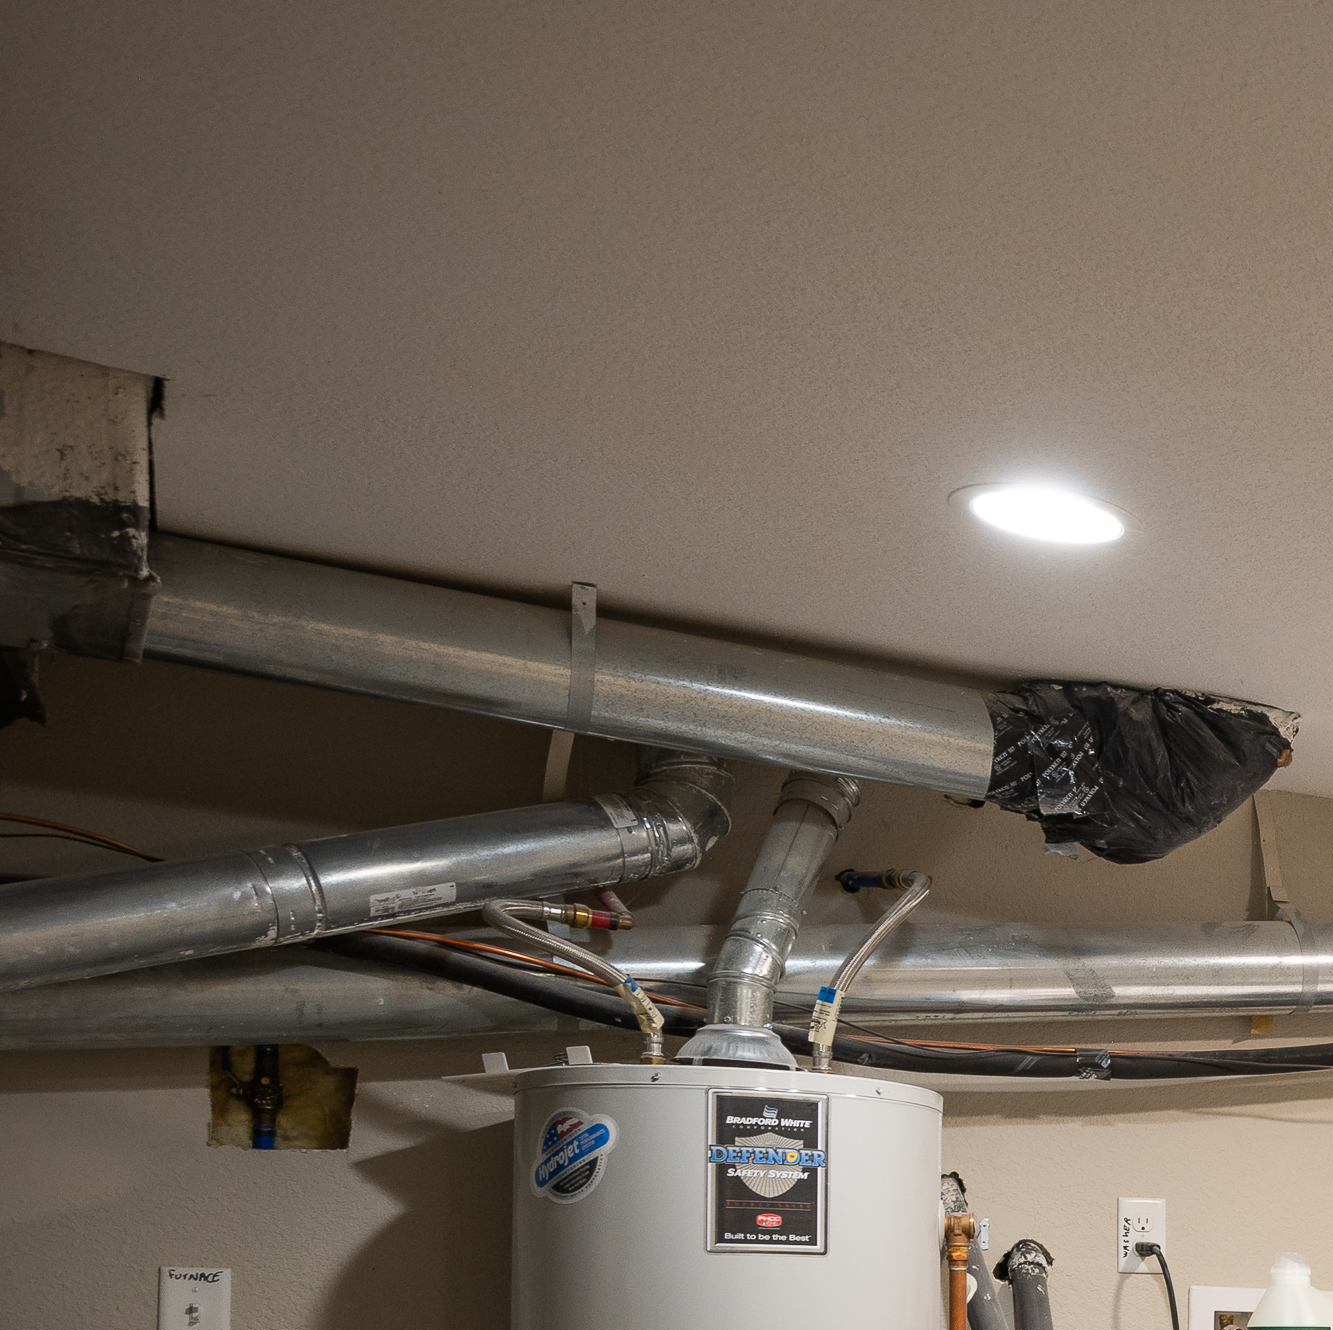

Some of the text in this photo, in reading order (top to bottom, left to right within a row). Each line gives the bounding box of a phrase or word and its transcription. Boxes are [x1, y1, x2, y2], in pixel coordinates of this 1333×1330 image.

[726, 1115, 813, 1128] BRADFORD WHITE
[538, 1140, 580, 1181] Hydrojet
[709, 1145, 826, 1167] DEFENDER
[727, 1168, 808, 1179] SAFETY SYSTEM
[772, 1233, 787, 1241] the
[789, 1234, 809, 1242] Best
